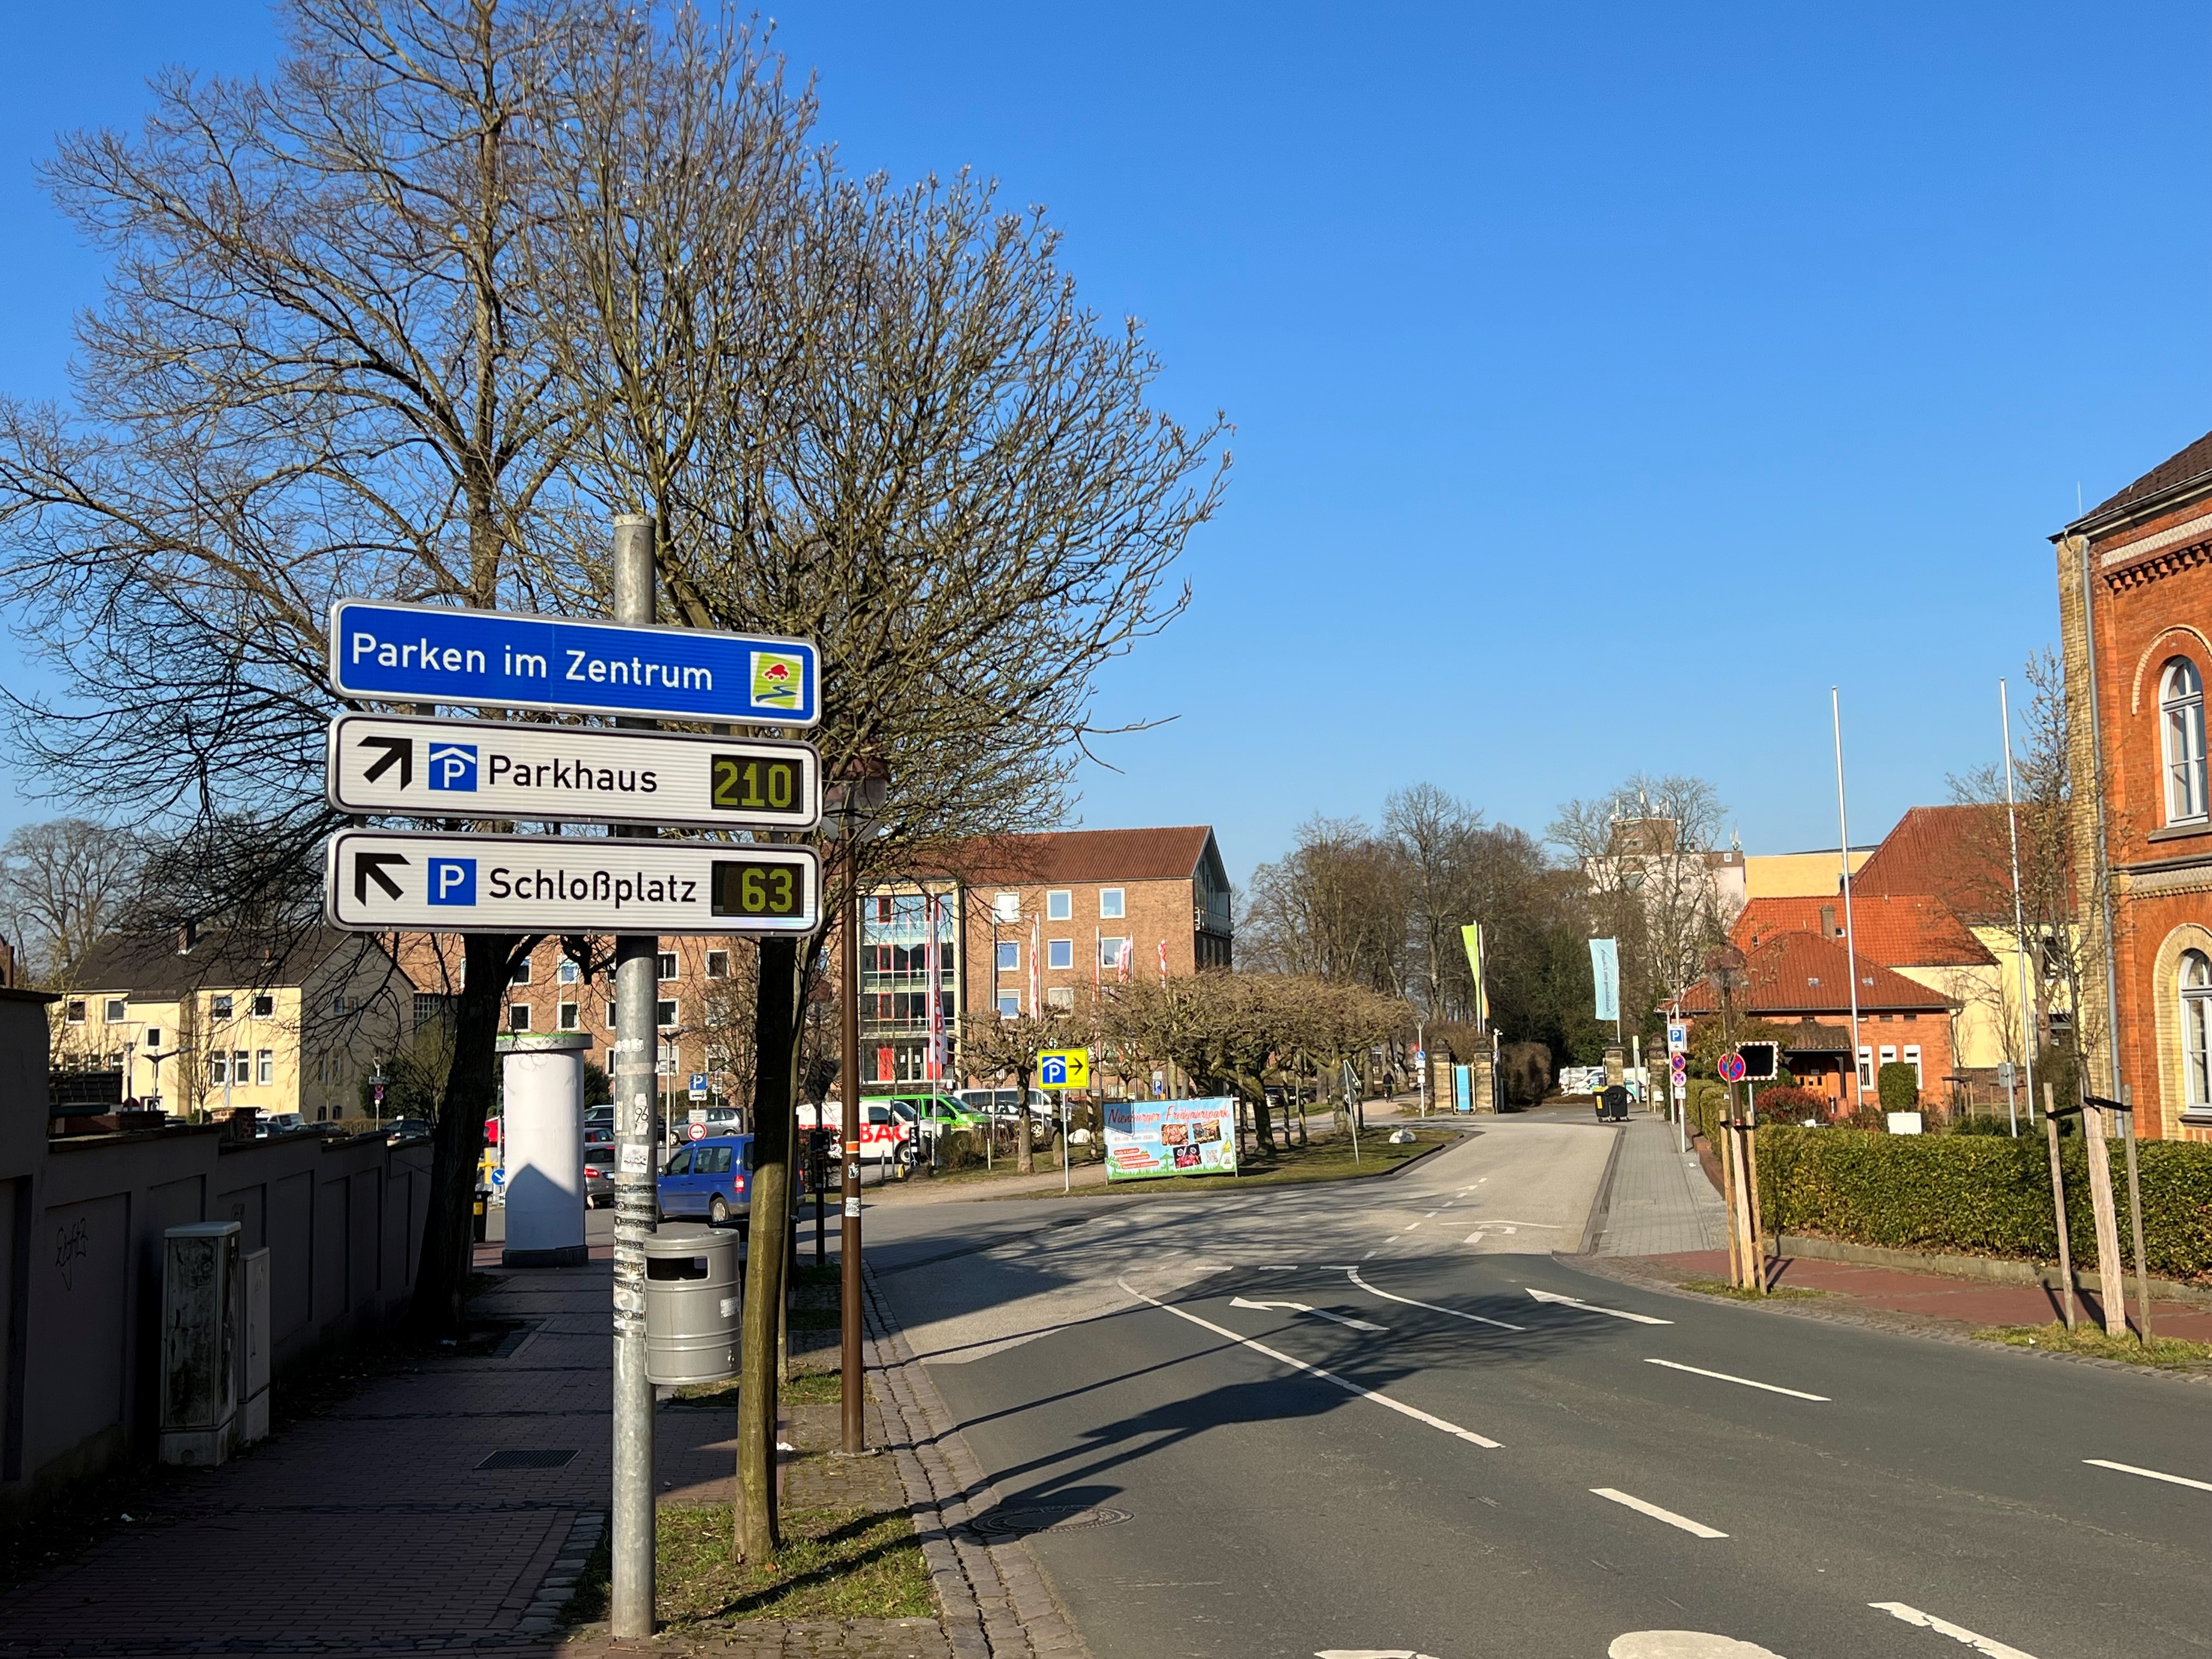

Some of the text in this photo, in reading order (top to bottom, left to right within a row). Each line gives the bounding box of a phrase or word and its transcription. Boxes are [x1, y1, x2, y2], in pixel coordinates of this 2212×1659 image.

[353, 632, 712, 691] Parken im Zentrum
[444, 755, 658, 793] P Parkhaus
[714, 761, 792, 808] 210
[439, 865, 697, 909] P Schloßplatz
[741, 868, 793, 912] 63
[1049, 1064, 1060, 1083] P
